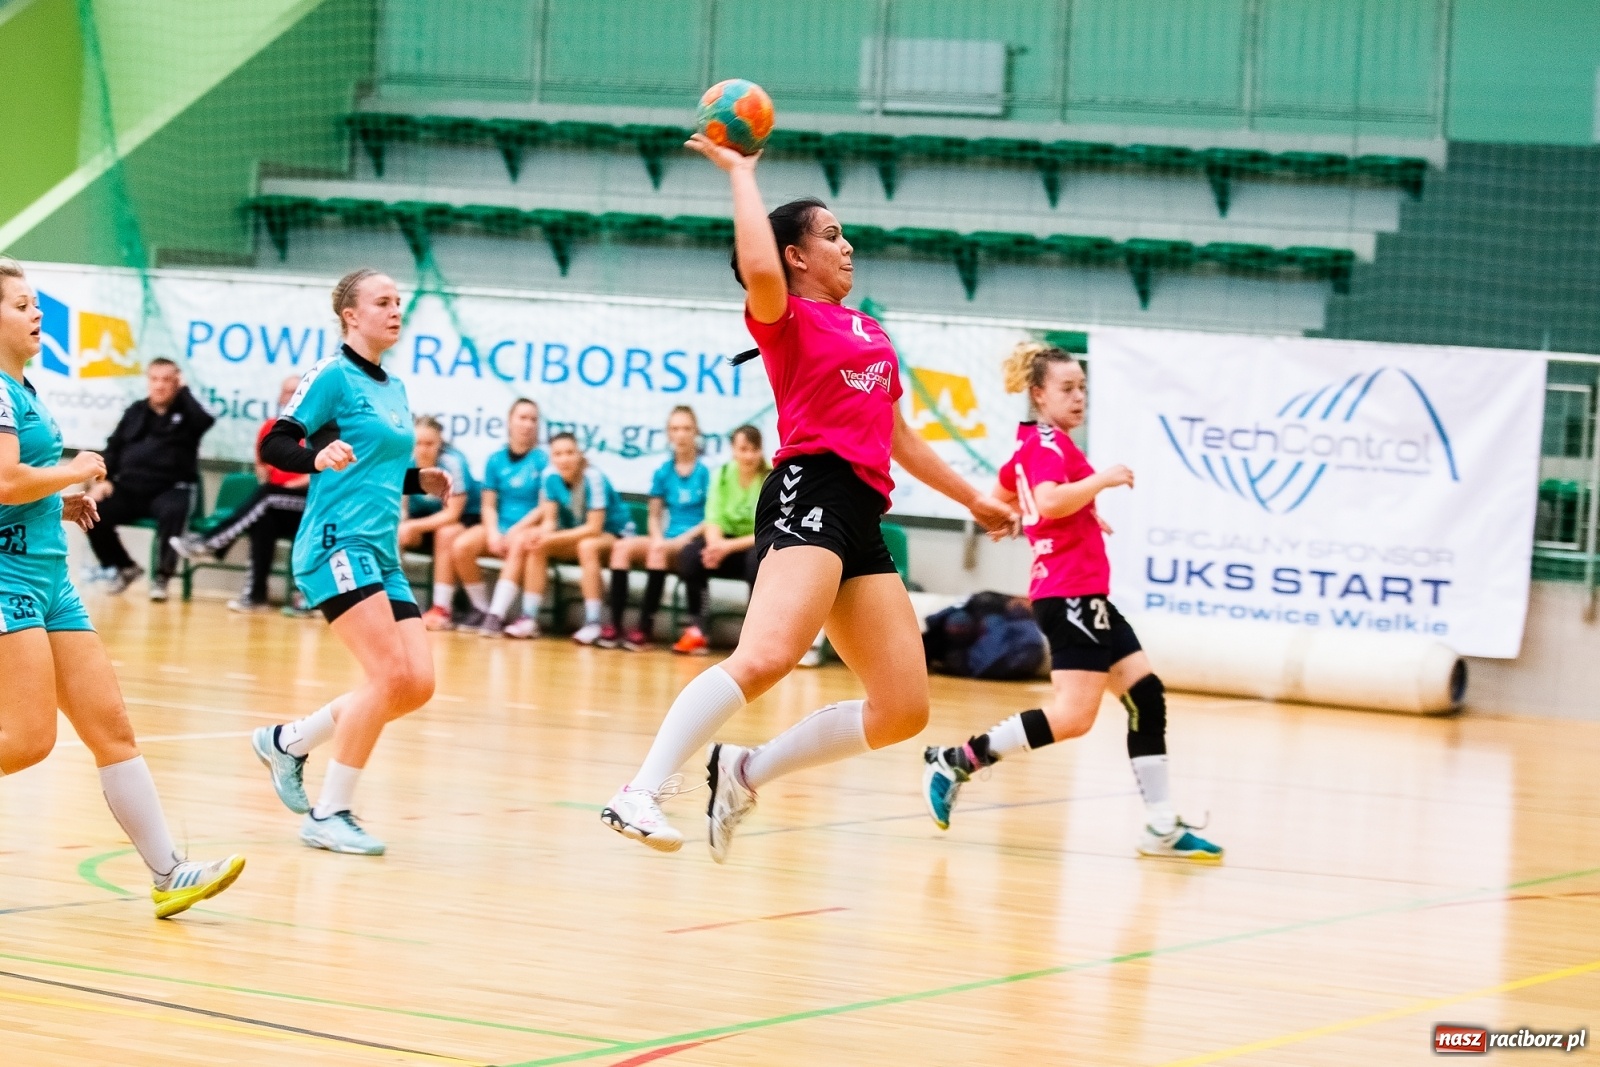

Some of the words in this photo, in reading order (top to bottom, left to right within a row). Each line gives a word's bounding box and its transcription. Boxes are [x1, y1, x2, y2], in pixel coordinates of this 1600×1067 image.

[851, 314, 872, 343] 4
[185, 319, 345, 366] POWI
[411, 334, 743, 397] RACIBORSKI
[1178, 415, 1431, 464] TechControl
[322, 523, 337, 549] 6
[801, 506, 824, 532] 4
[1146, 526, 1301, 555] OFICJALNY
[1307, 538, 1456, 568] SPONSOR
[359, 556, 374, 575] 6
[1145, 556, 1256, 592] UKS
[1271, 566, 1453, 607] START
[9, 595, 36, 620] 33
[1144, 592, 1320, 626] Pietrowice
[1330, 607, 1450, 635] Wielkie
